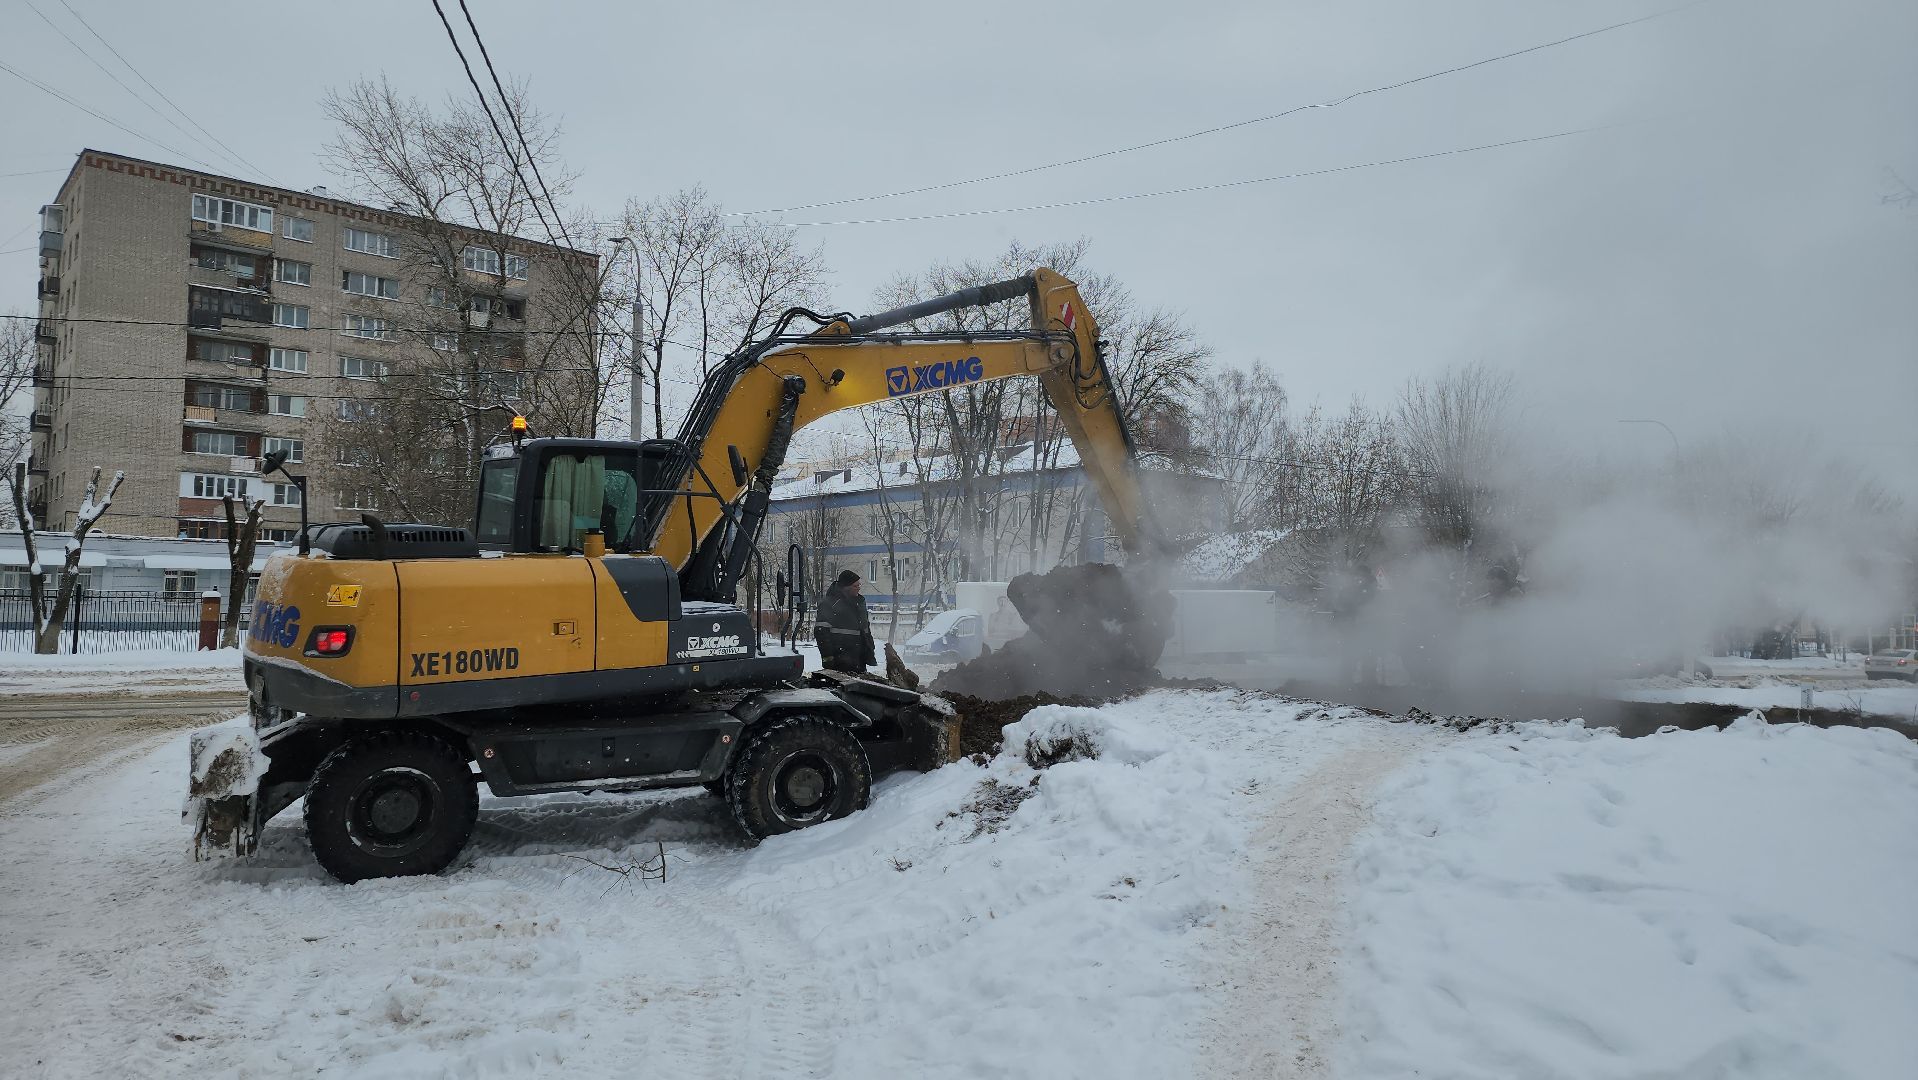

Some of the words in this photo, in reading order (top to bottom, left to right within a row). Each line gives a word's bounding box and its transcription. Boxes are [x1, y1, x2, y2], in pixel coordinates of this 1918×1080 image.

[912, 356, 983, 392] XCMG
[700, 635, 740, 649] XCMG
[411, 648, 519, 677] XE180WD
